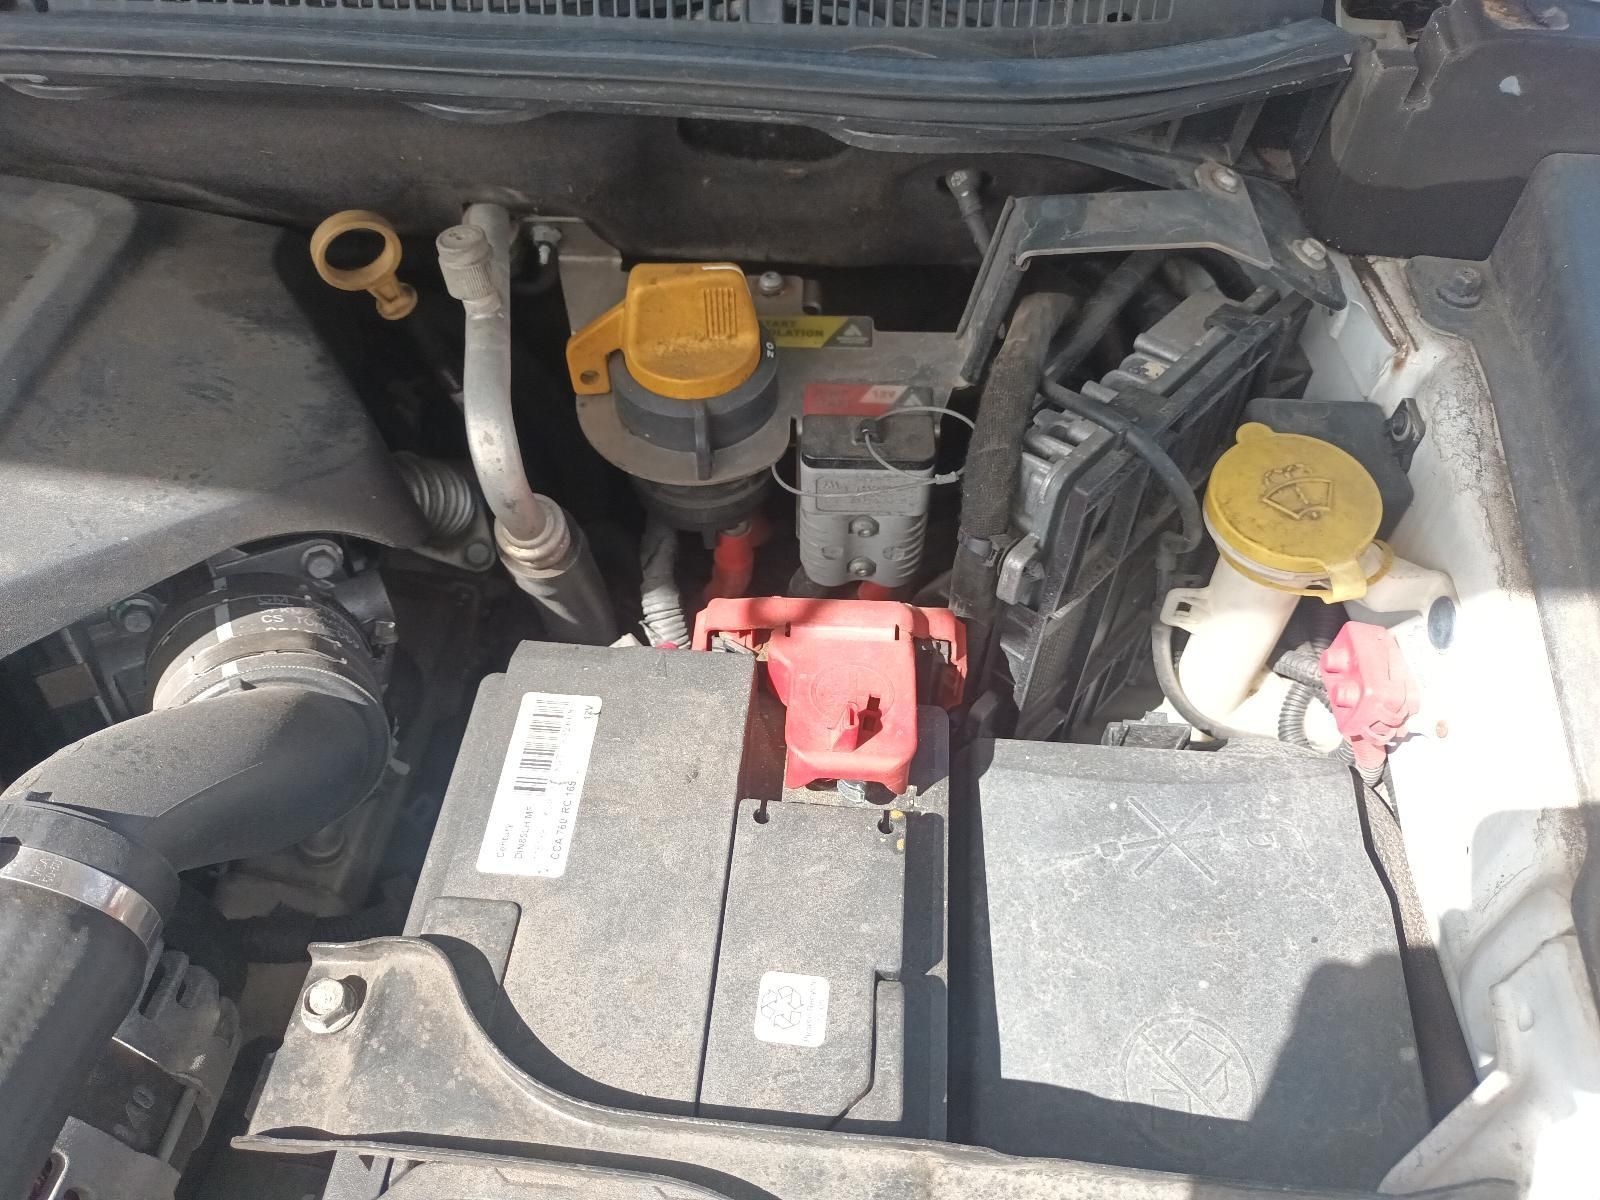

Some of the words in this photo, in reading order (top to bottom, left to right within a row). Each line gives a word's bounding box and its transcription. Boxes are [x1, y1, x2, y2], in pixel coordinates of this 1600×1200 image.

[765, 320, 796, 328] TART
[768, 328, 825, 338] OLATION
[562, 799, 572, 814] RC
